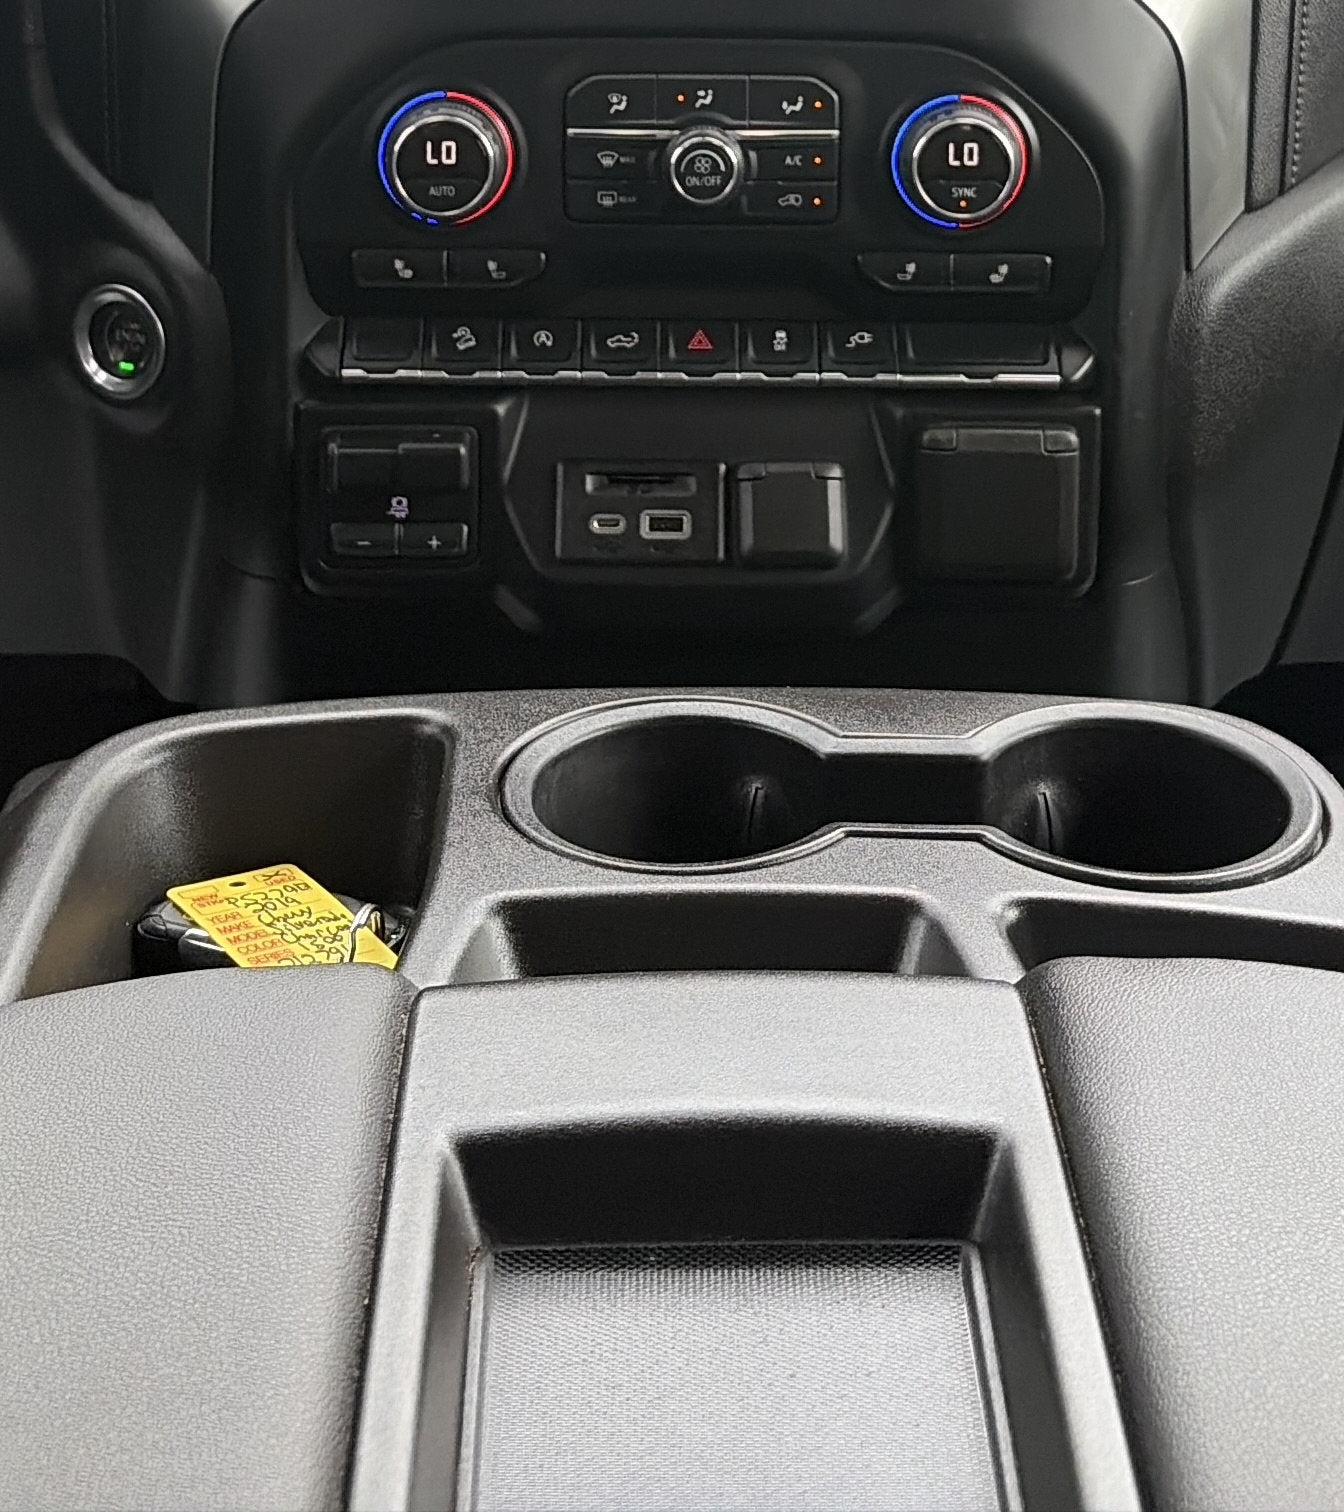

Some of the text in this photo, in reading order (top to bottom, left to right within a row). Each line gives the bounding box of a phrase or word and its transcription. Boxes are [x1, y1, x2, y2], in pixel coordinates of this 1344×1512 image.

[426, 140, 457, 165] LO
[948, 142, 979, 167] LO
[784, 155, 803, 167] A/C
[685, 175, 723, 187] ON/OFF
[428, 185, 456, 197] AUTO
[951, 186, 978, 198] SYNC
[206, 911, 244, 925] YEAR
[216, 920, 254, 934] MAKE
[226, 929, 273, 945] MODEL
[237, 938, 284, 955] COLOR
[248, 948, 295, 965] SERIES
